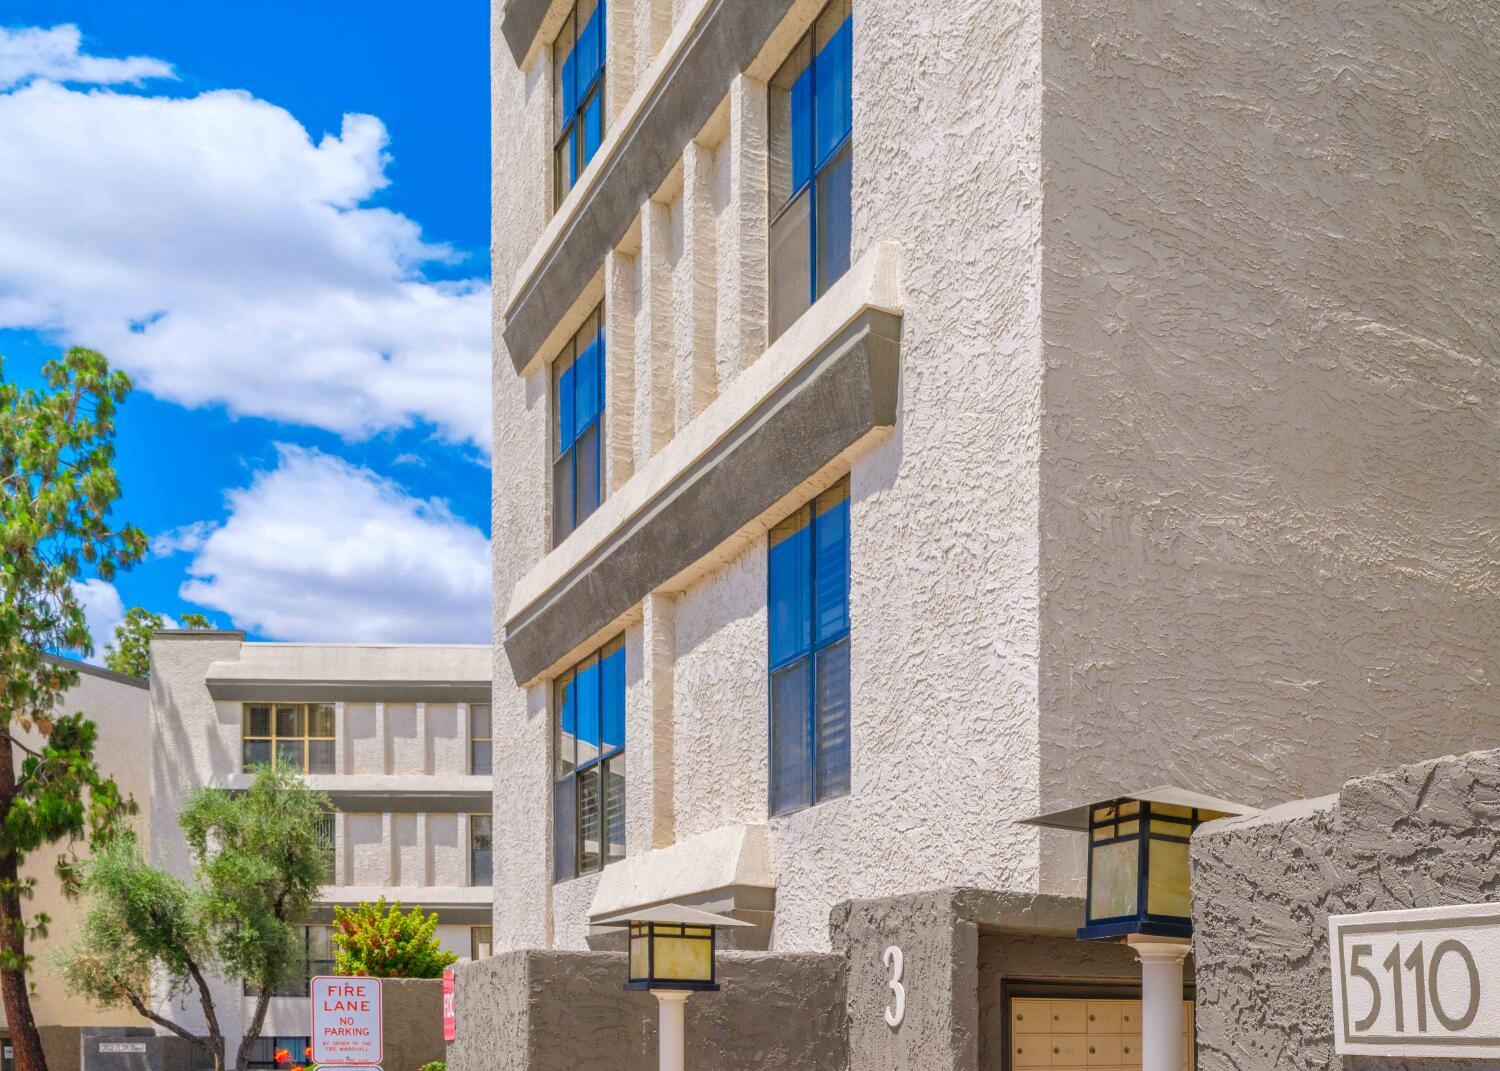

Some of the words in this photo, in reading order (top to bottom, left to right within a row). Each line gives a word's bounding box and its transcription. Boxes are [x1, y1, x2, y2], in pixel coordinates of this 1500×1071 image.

[327, 985, 366, 997] FIRE
[883, 945, 905, 1027] 3
[1348, 938, 1481, 1032] 5110
[324, 1000, 370, 1012] LANE
[339, 1017, 354, 1026] NO
[324, 1027, 370, 1036] PARKING
